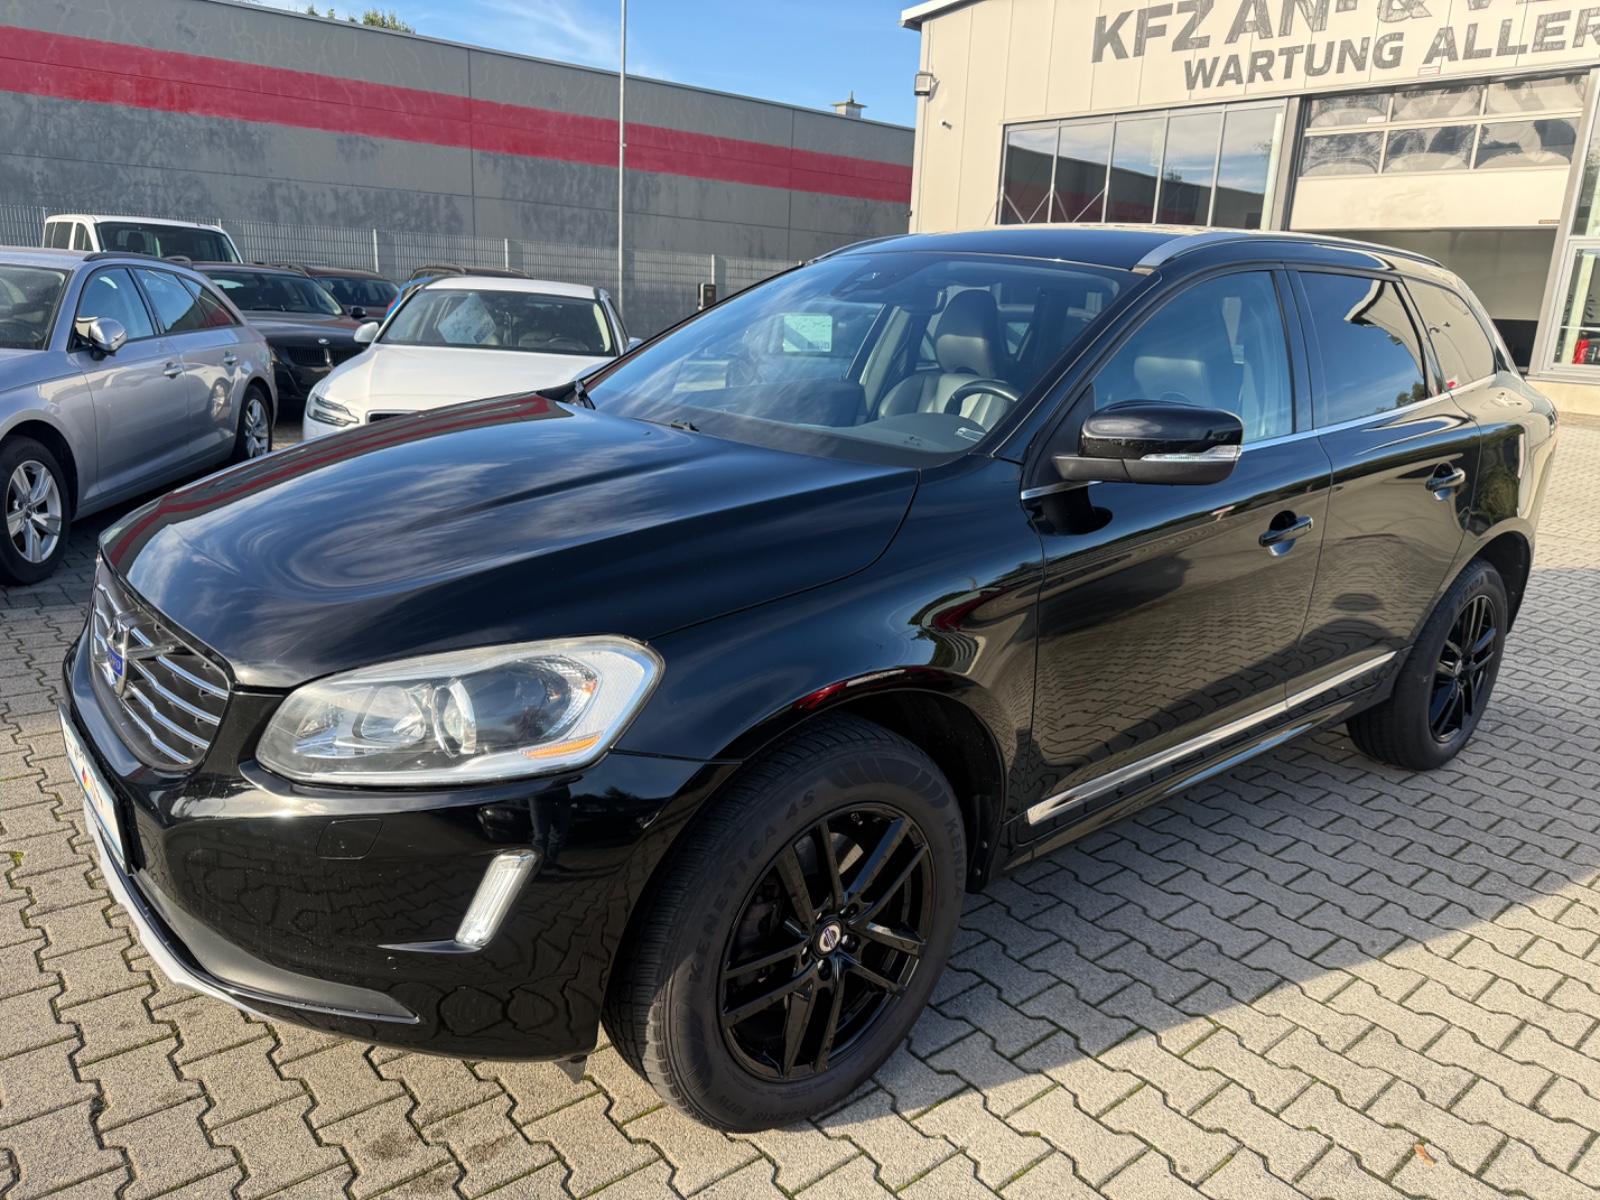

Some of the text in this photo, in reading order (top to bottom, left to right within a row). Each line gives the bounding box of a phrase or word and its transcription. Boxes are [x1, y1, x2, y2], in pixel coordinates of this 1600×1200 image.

[1091, 0, 1215, 64] KFZ
[1184, 7, 1600, 91] WARTUNG ALLER
